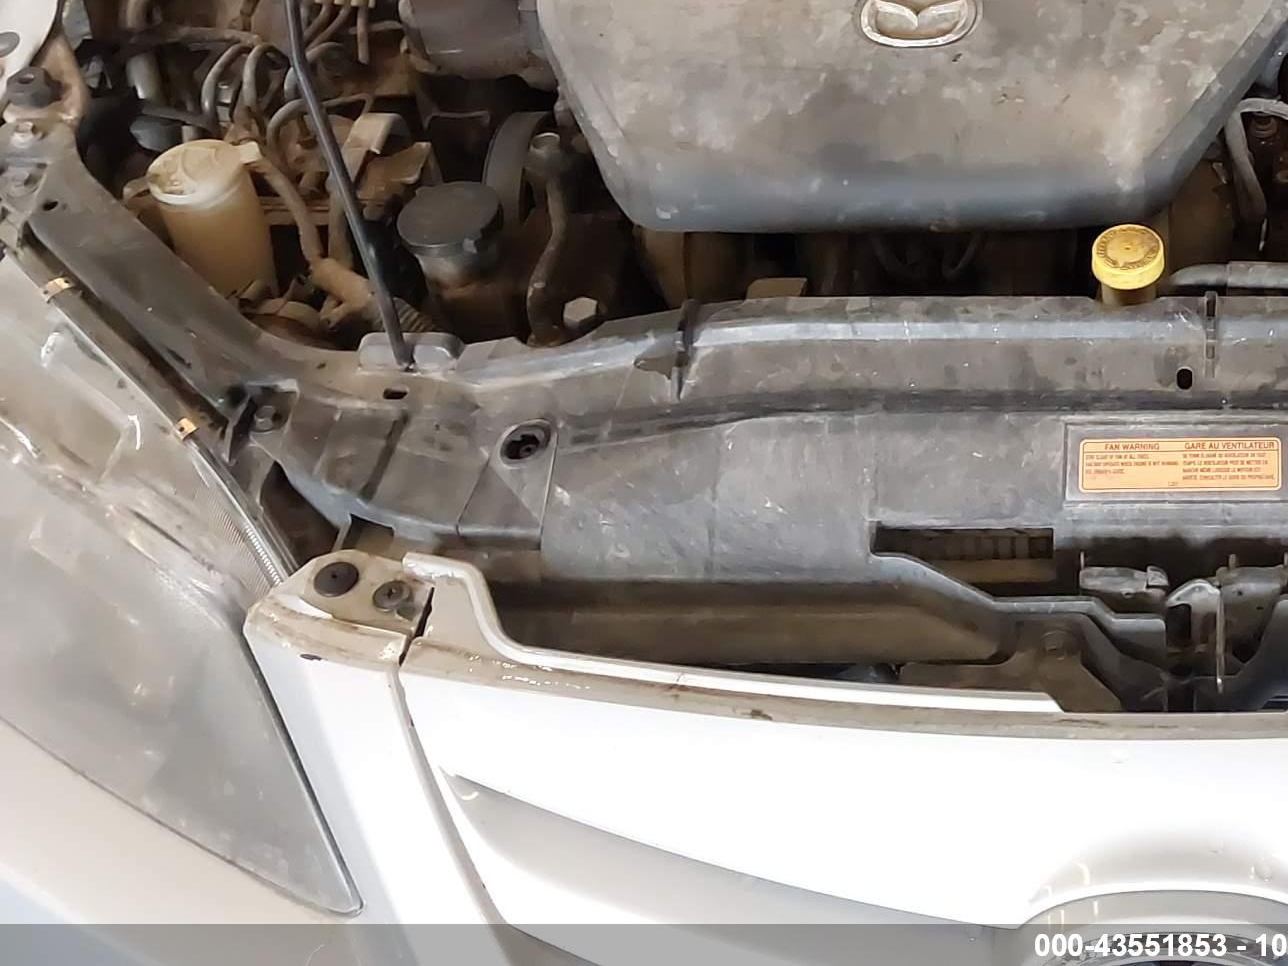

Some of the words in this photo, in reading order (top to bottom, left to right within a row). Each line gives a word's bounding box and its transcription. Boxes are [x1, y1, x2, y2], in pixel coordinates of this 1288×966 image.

[1104, 443, 1120, 451] FAN
[1184, 442, 1207, 450] GARE
[1208, 442, 1220, 450] AU
[1222, 441, 1275, 449] VENTILATEUR
